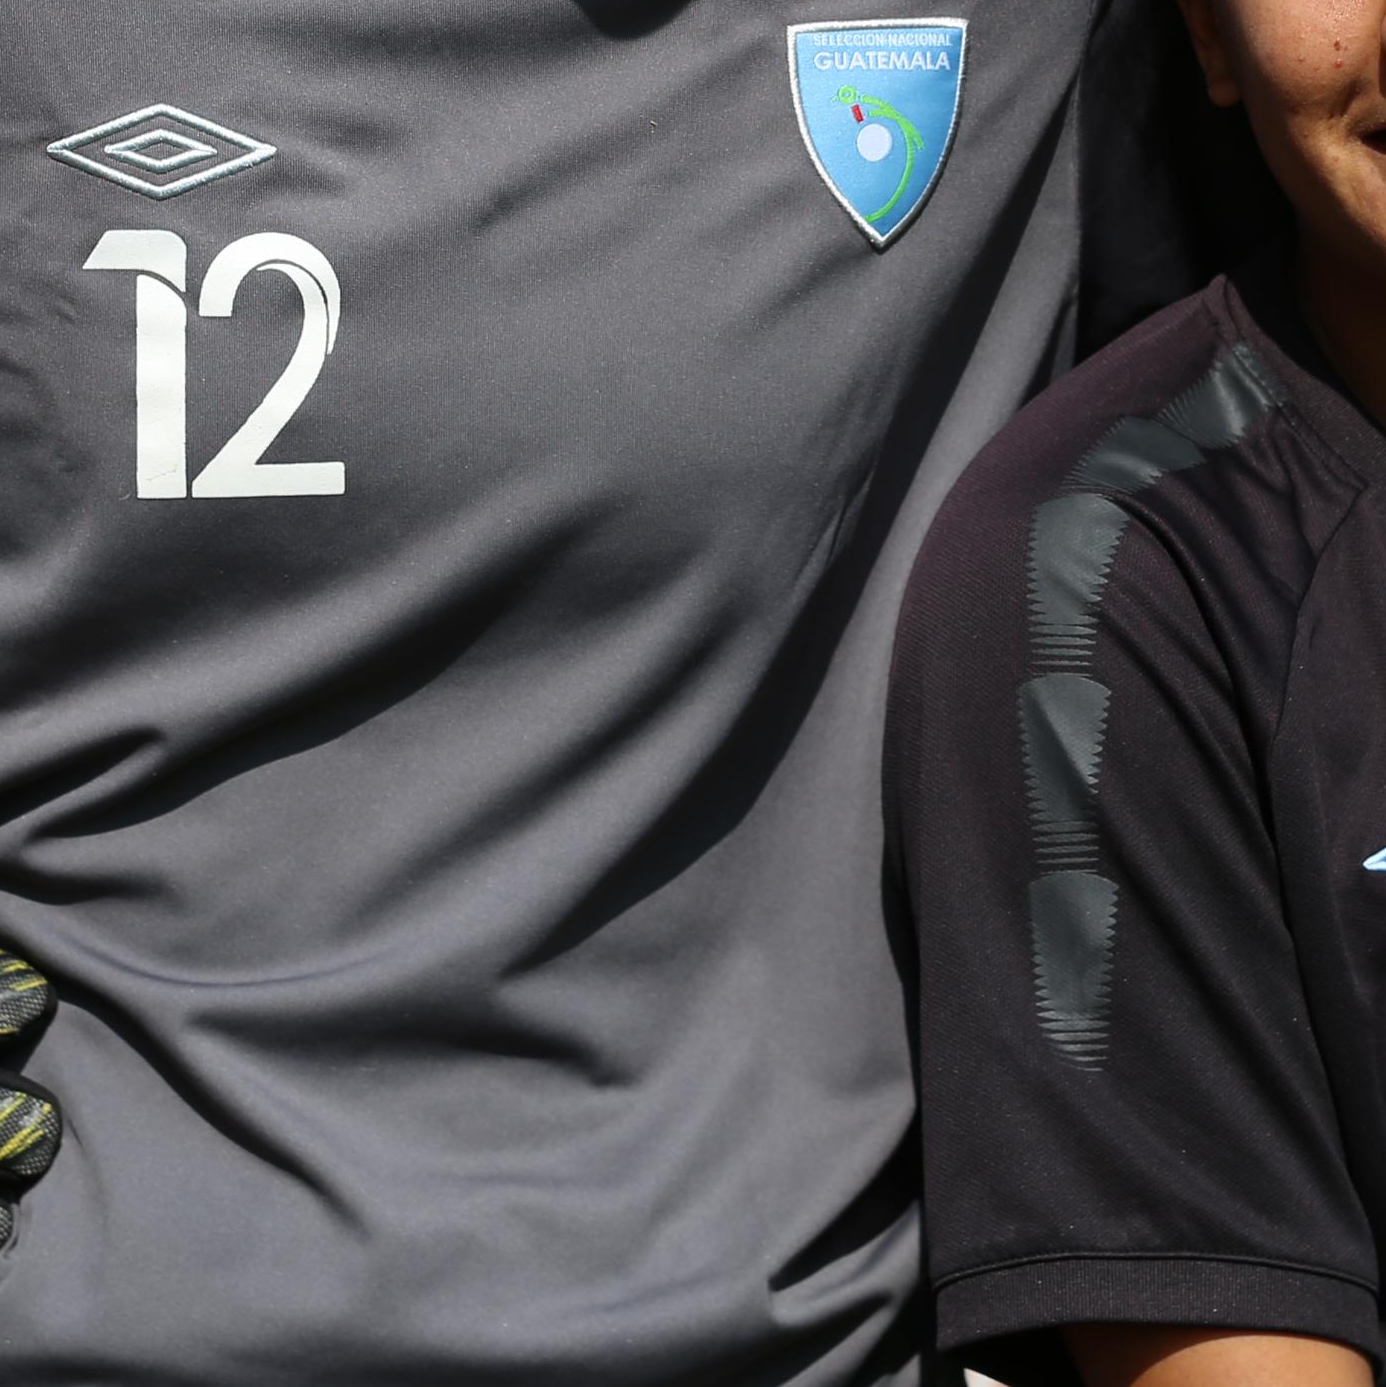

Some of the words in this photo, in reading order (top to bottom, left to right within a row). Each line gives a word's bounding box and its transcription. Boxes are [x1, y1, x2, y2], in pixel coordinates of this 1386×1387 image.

[813, 33, 885, 47] SELECCION
[888, 32, 952, 47] NACIONAL
[813, 50, 950, 71] GUATEMALA
[82, 229, 345, 499] 12
